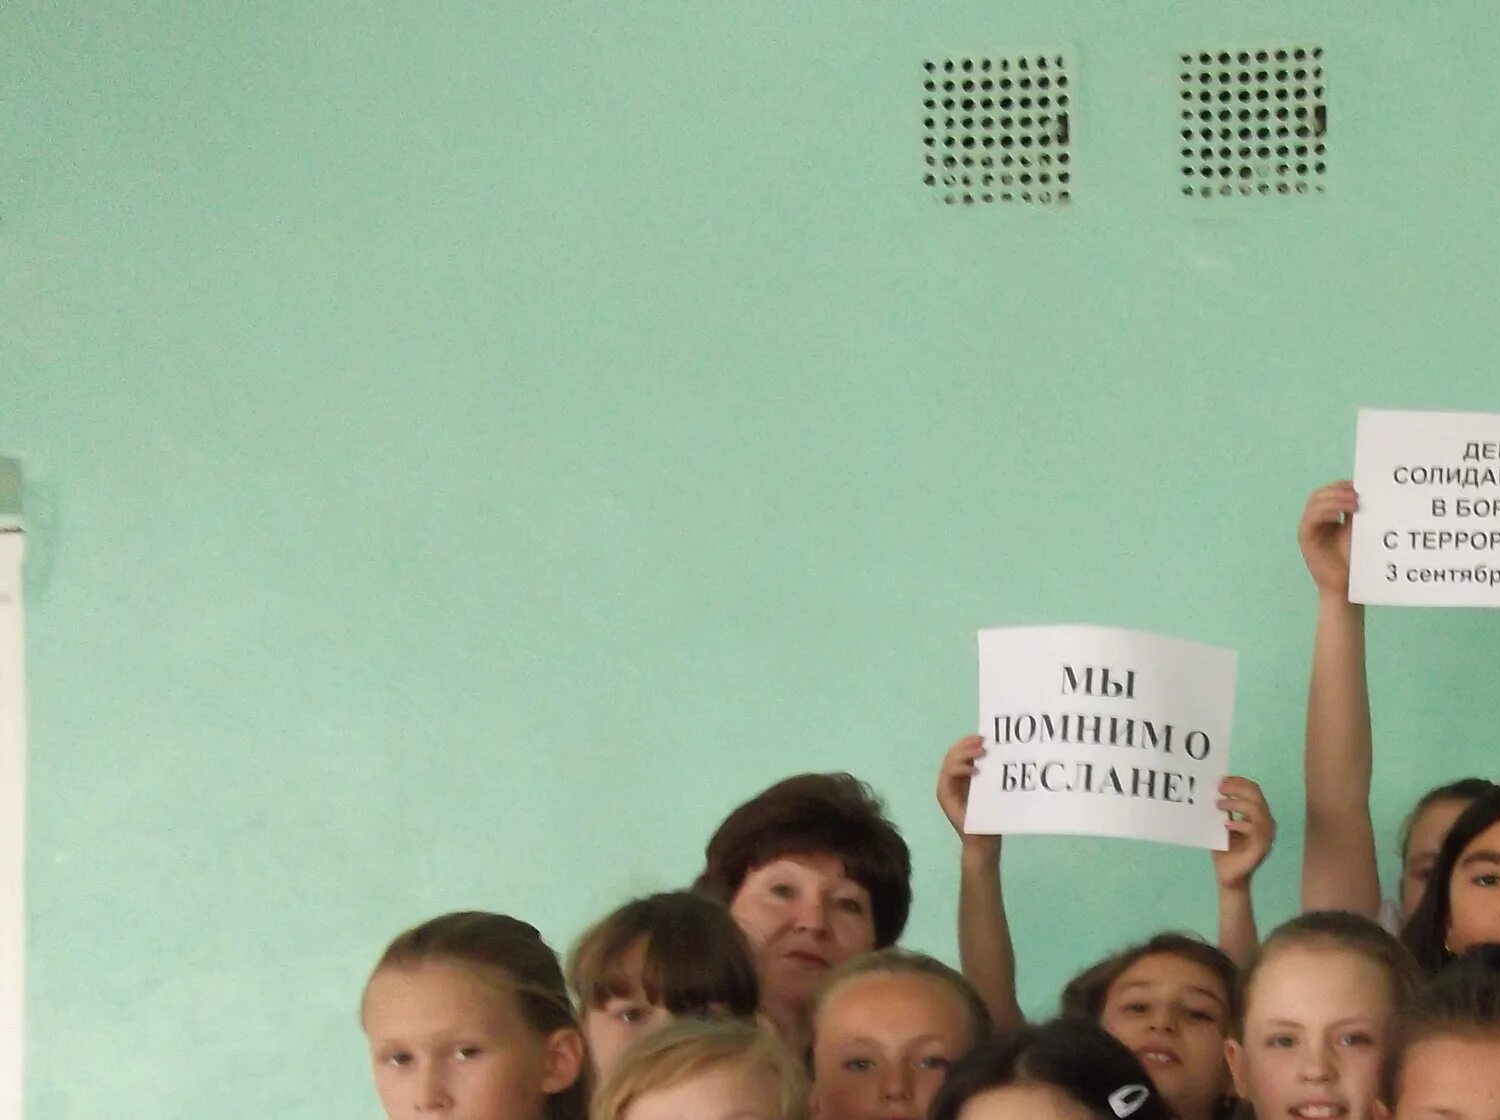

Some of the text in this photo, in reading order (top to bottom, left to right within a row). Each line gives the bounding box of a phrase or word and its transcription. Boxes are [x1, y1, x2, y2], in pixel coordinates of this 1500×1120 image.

[1431, 498, 1447, 517] В
[1383, 531, 1399, 550] С
[1386, 563, 1398, 582] 3
[1061, 664, 1137, 701] МЫ
[993, 714, 1211, 761] ПОМНИМ О
[1001, 759, 1196, 805] БЕСЛАНЕ!
